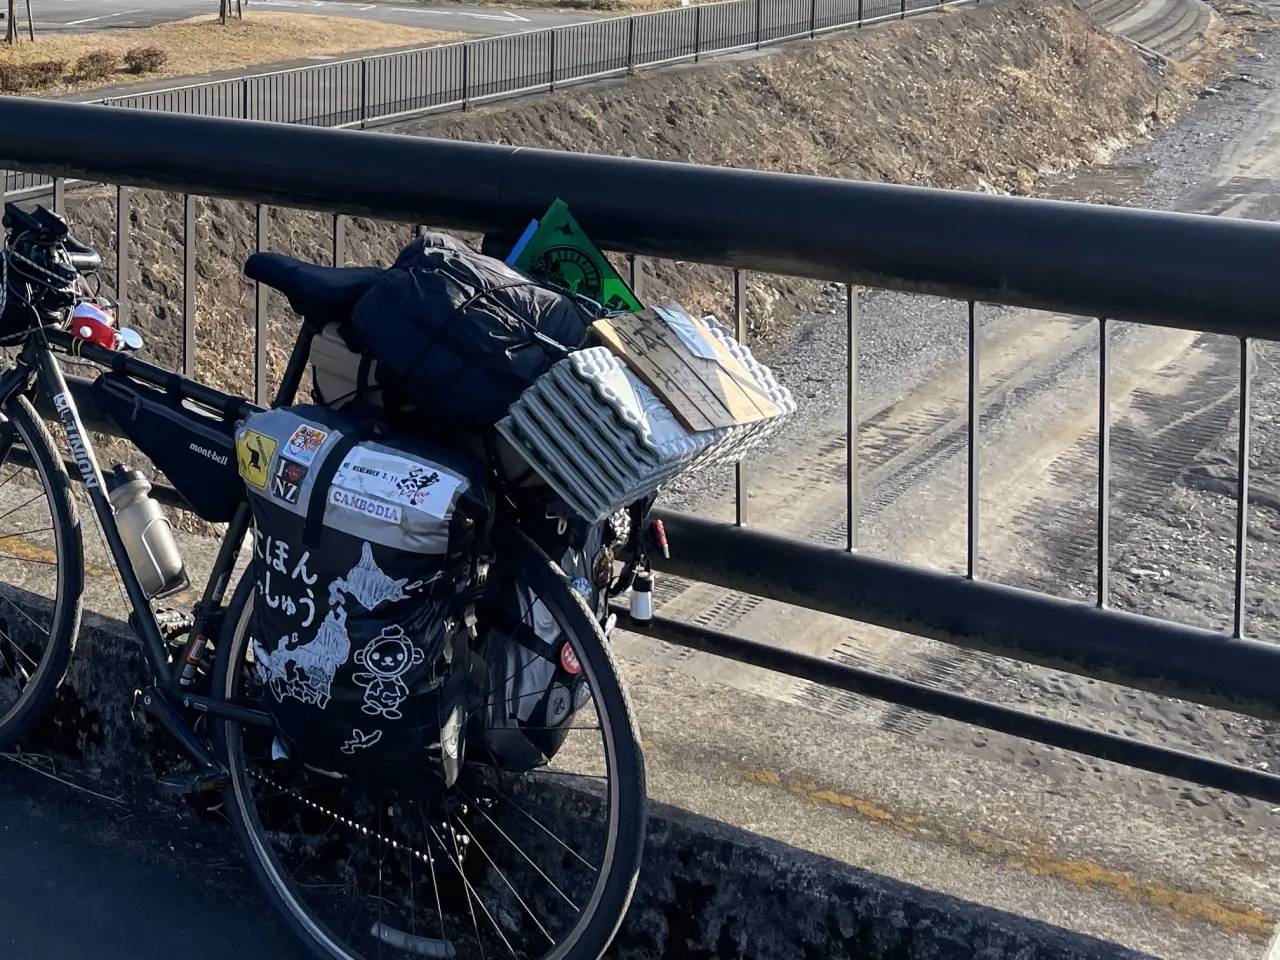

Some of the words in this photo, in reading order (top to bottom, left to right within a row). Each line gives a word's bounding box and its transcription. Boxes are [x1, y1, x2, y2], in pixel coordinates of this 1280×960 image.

[276, 459, 287, 477] I
[273, 477, 298, 502] NZ
[333, 491, 399, 521] CAMBODIA
